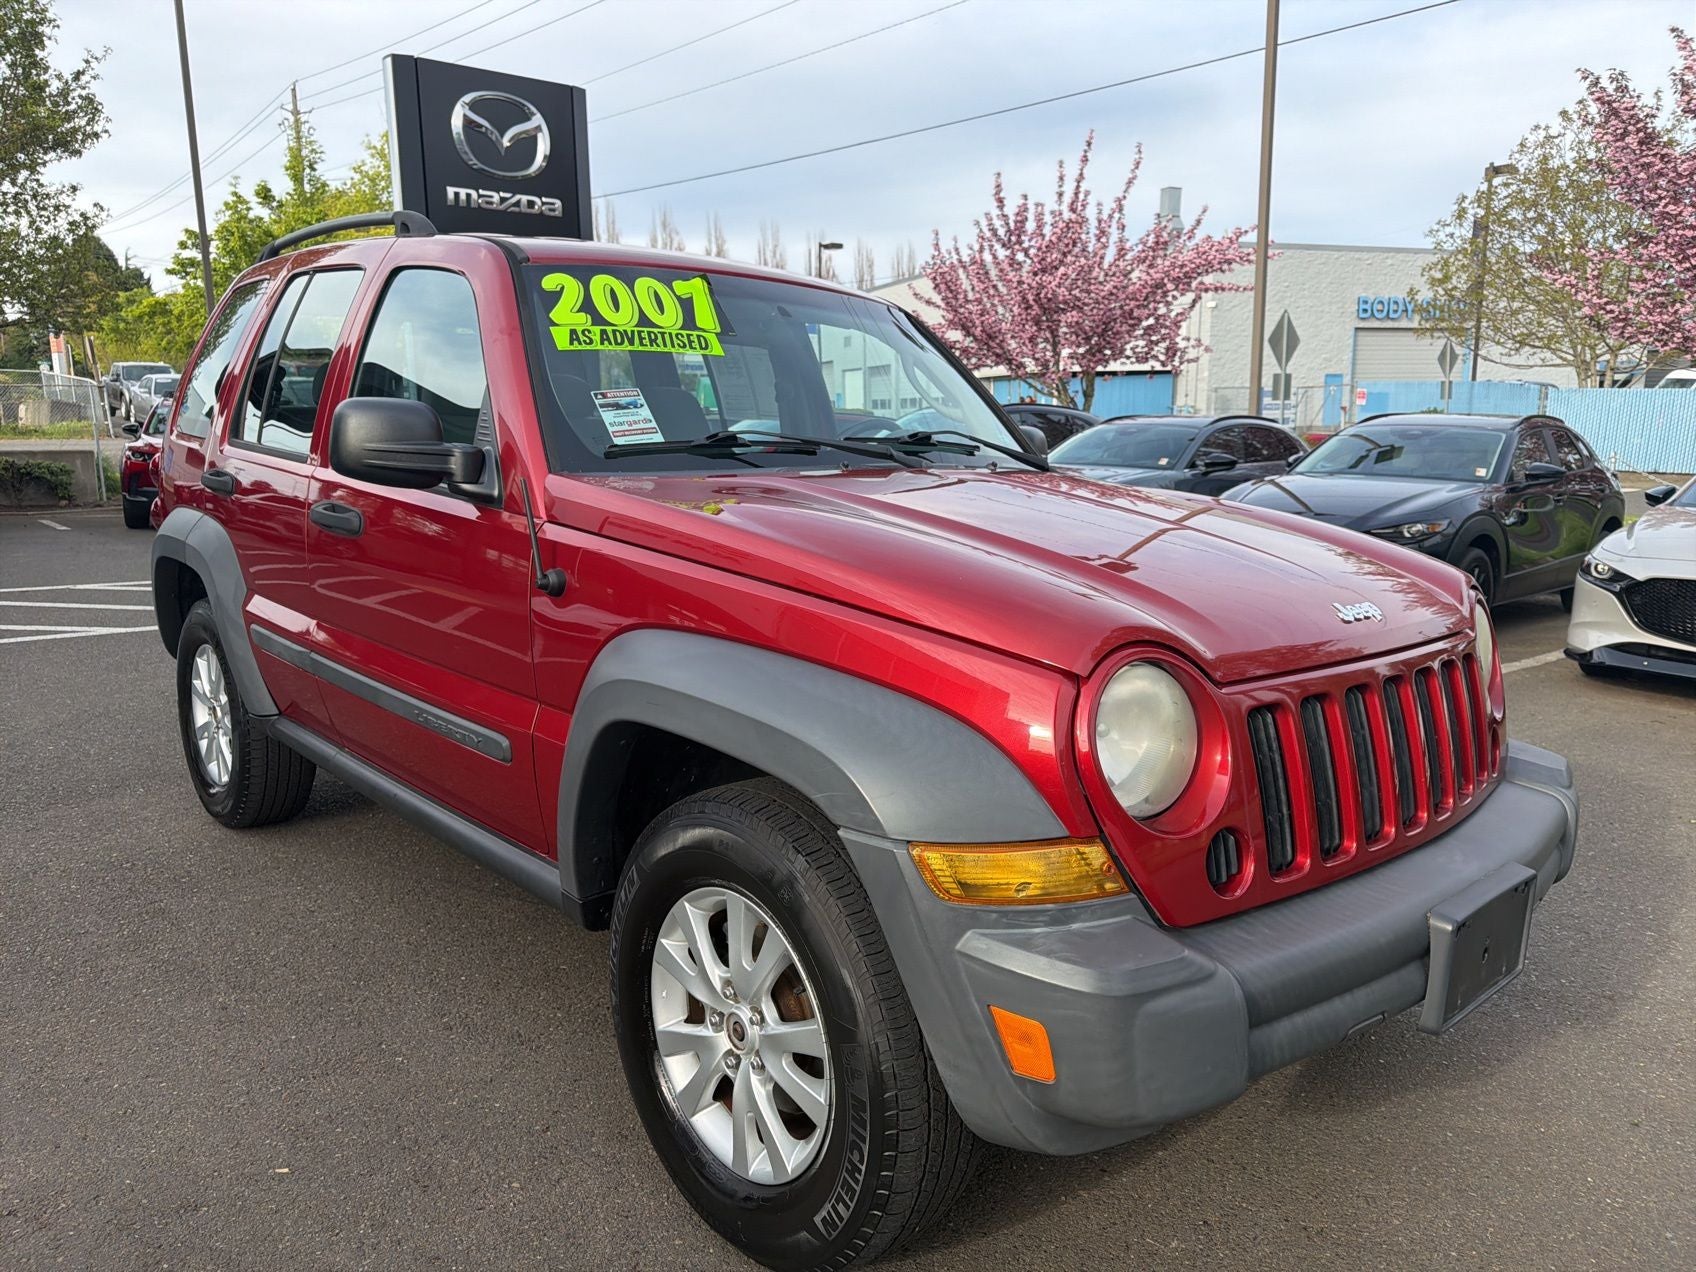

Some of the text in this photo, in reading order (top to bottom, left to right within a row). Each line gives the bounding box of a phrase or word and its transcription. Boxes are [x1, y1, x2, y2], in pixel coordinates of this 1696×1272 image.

[446, 186, 563, 218] mazda
[541, 272, 721, 334] 2007
[1357, 296, 1414, 320] BODY
[569, 328, 711, 352] AS ADVERTISED
[1331, 601, 1383, 624] Jeep
[815, 1091, 869, 1240] MICHELIN
